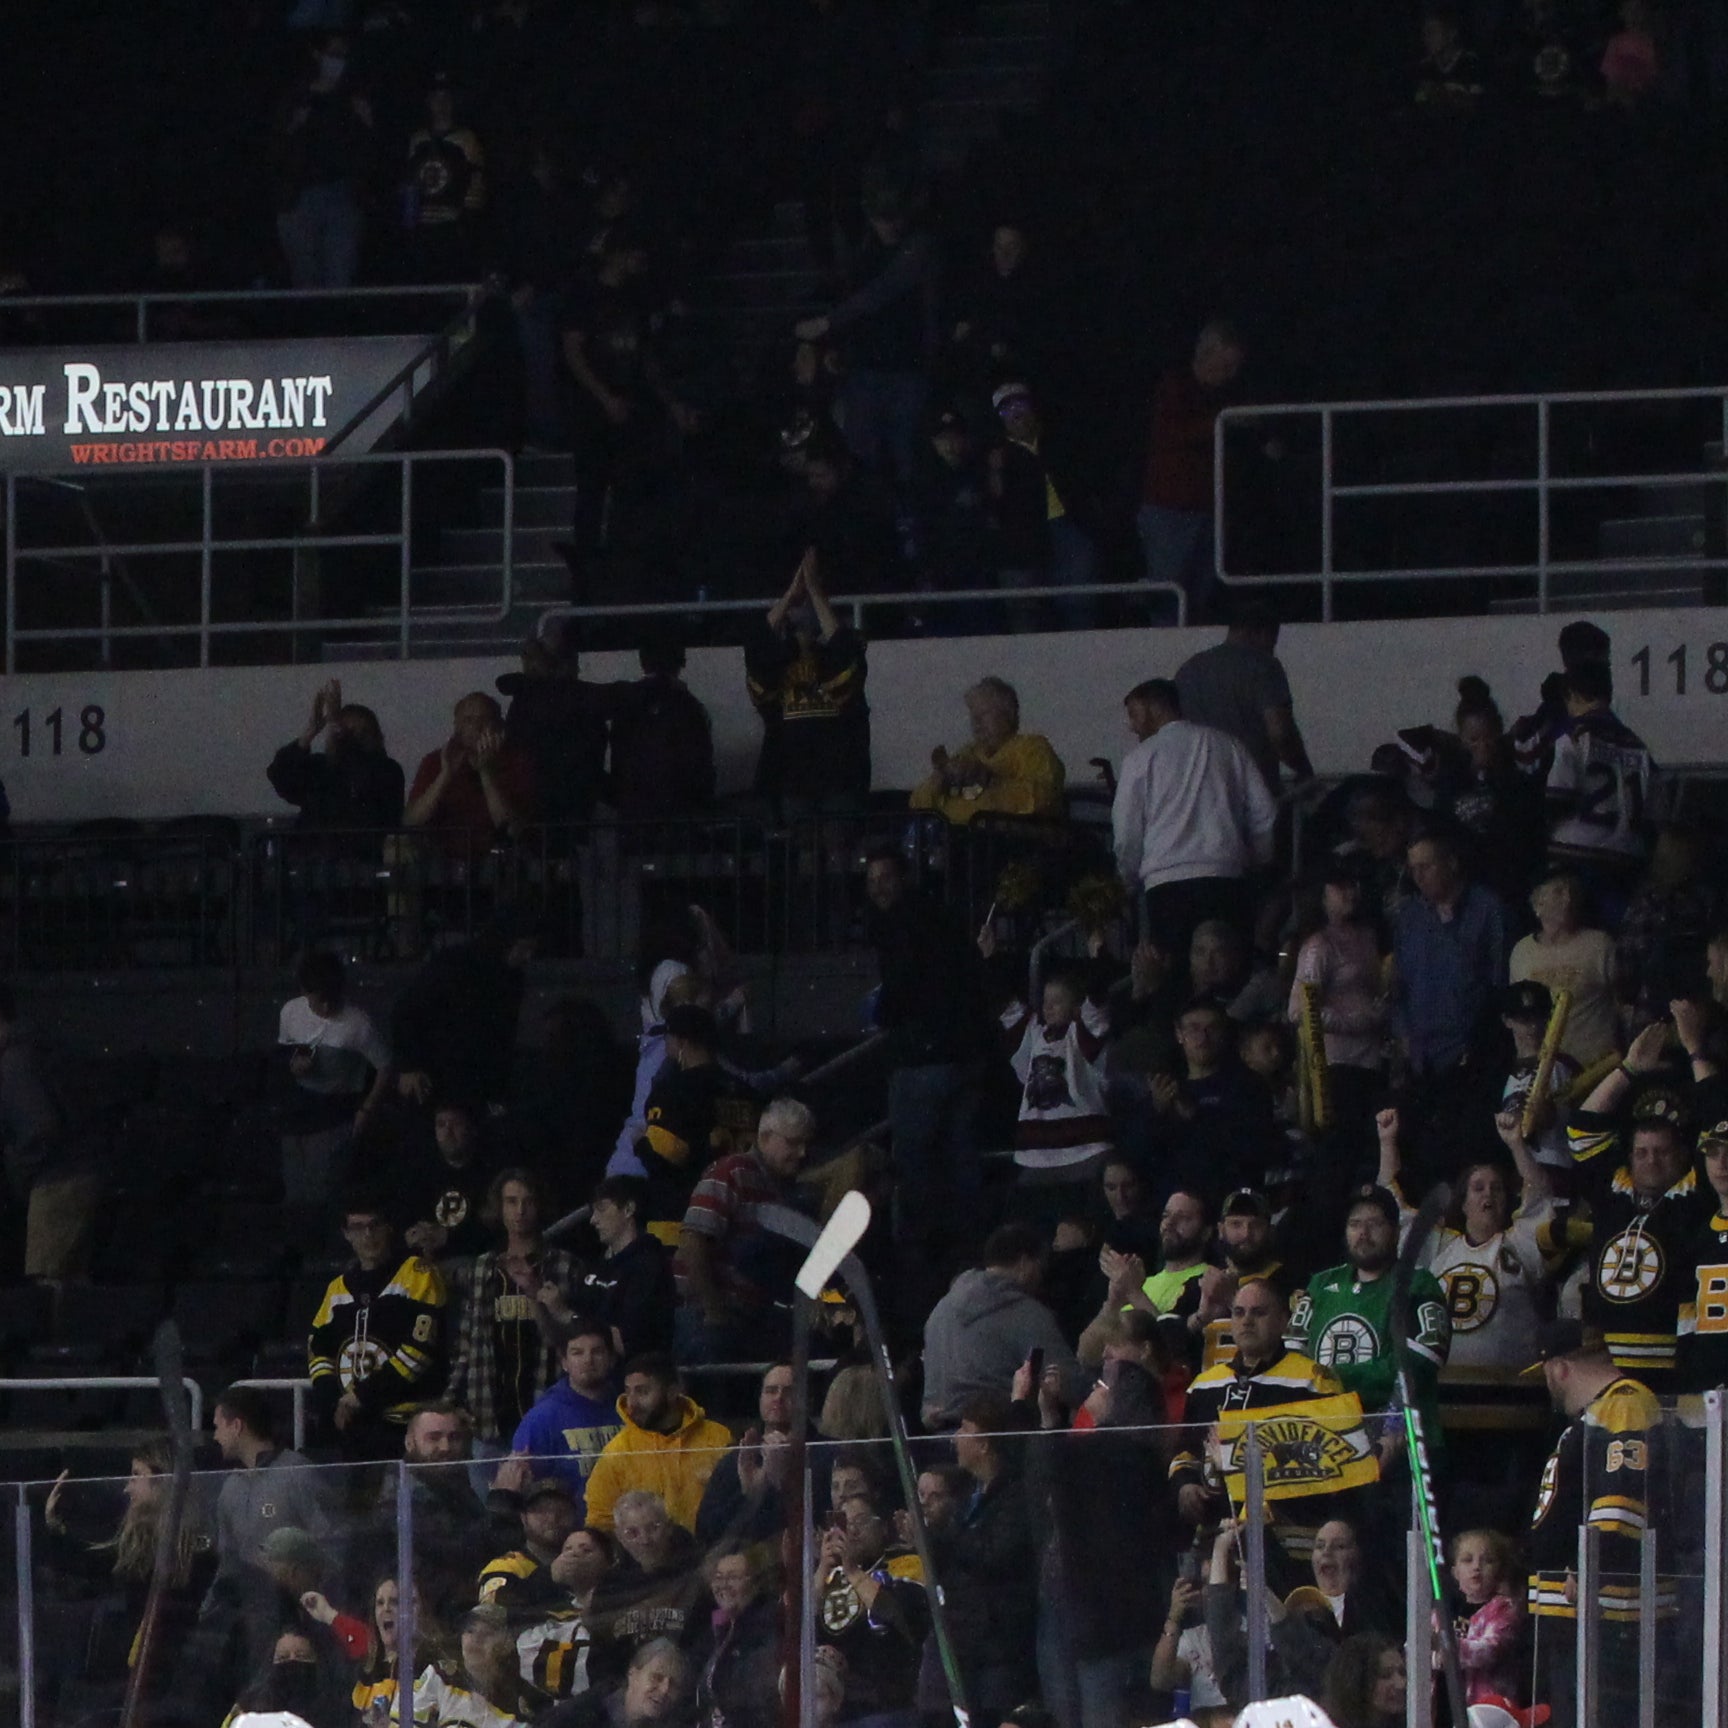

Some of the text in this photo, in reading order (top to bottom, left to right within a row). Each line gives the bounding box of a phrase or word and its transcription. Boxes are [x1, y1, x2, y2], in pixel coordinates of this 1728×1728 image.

[69, 436, 328, 466] WRIGHTSFARM.COM
[1630, 640, 1728, 696] 118
[12, 703, 107, 757] 118
[1604, 1439, 1647, 1473] 63
